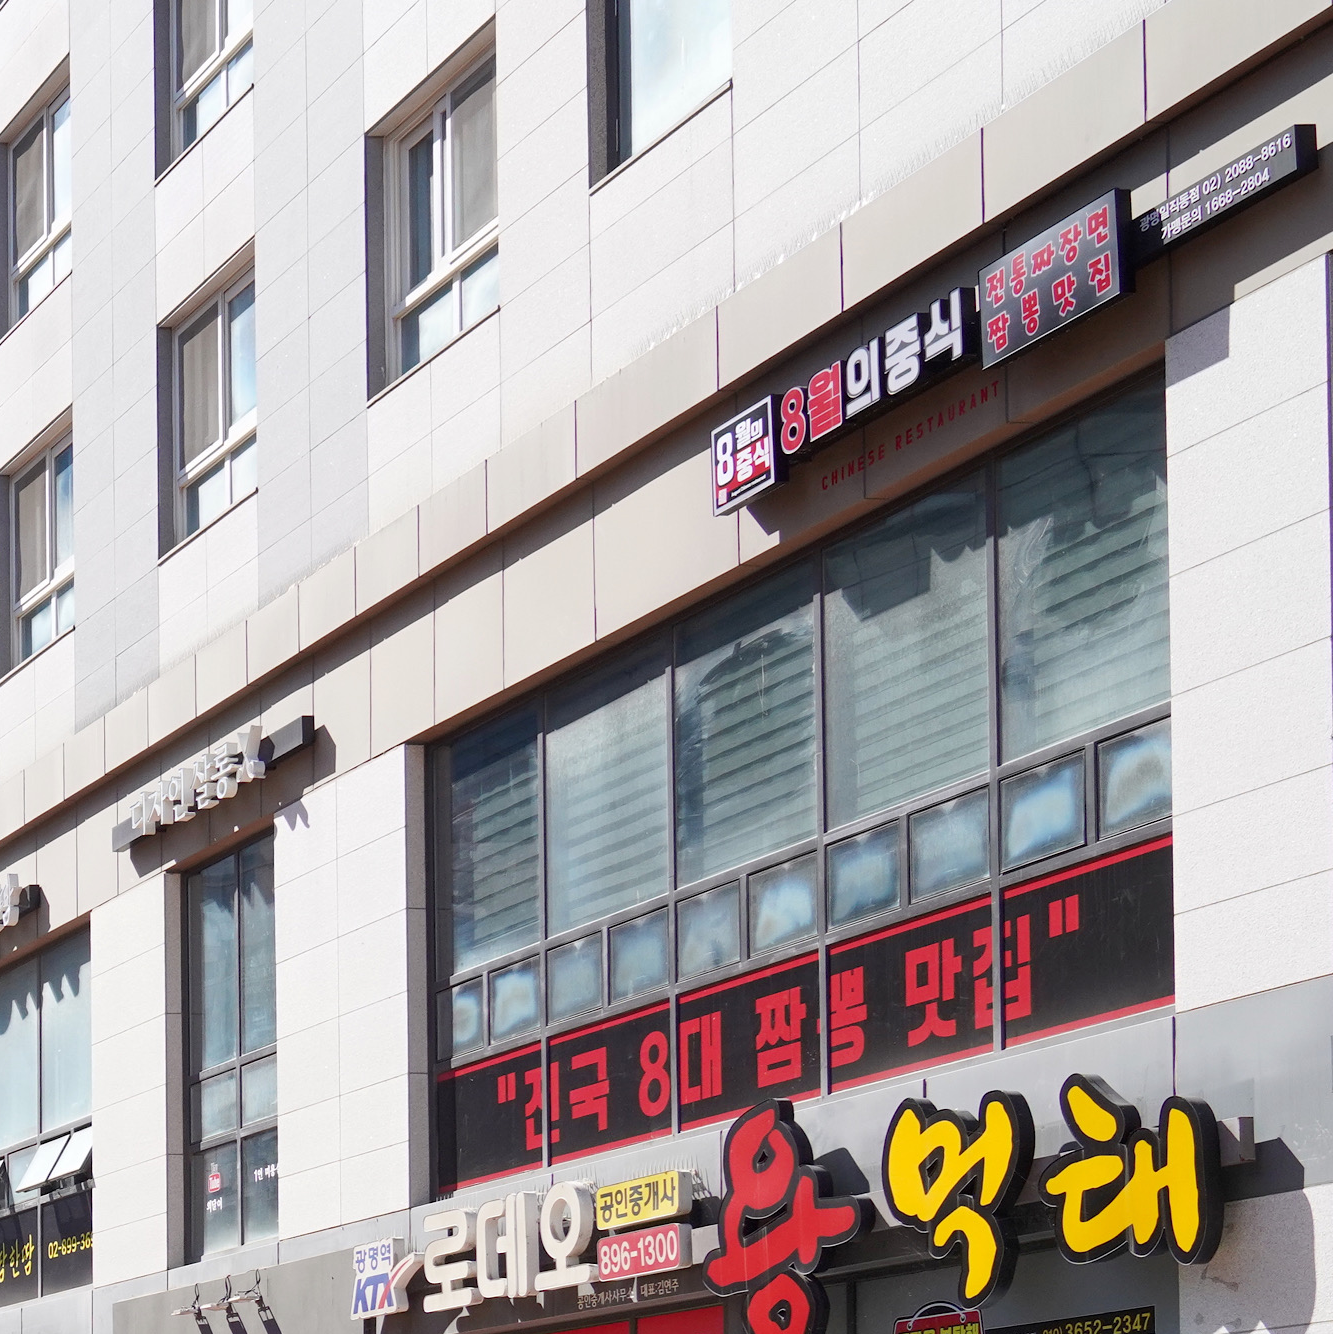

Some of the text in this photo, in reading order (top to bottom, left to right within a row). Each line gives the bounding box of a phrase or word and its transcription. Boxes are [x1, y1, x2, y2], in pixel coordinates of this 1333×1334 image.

[1139, 133, 1291, 233] 광명일직동점 02) 2088-8616
[1160, 168, 1270, 241] 가맹문의 1668-2804
[985, 204, 1111, 306] 전통짜장면
[736, 437, 770, 482] 중식
[821, 380, 1001, 492] CHINESE RESTAURANT
[638, 1011, 722, 1118] 8대
[755, 966, 867, 1088] 짬뽕
[596, 1174, 678, 1231] 공인중개사
[353, 1242, 393, 1280] 광명역
[423, 1180, 678, 1313] 로데오 896-1300
[352, 1275, 401, 1317] KTX
